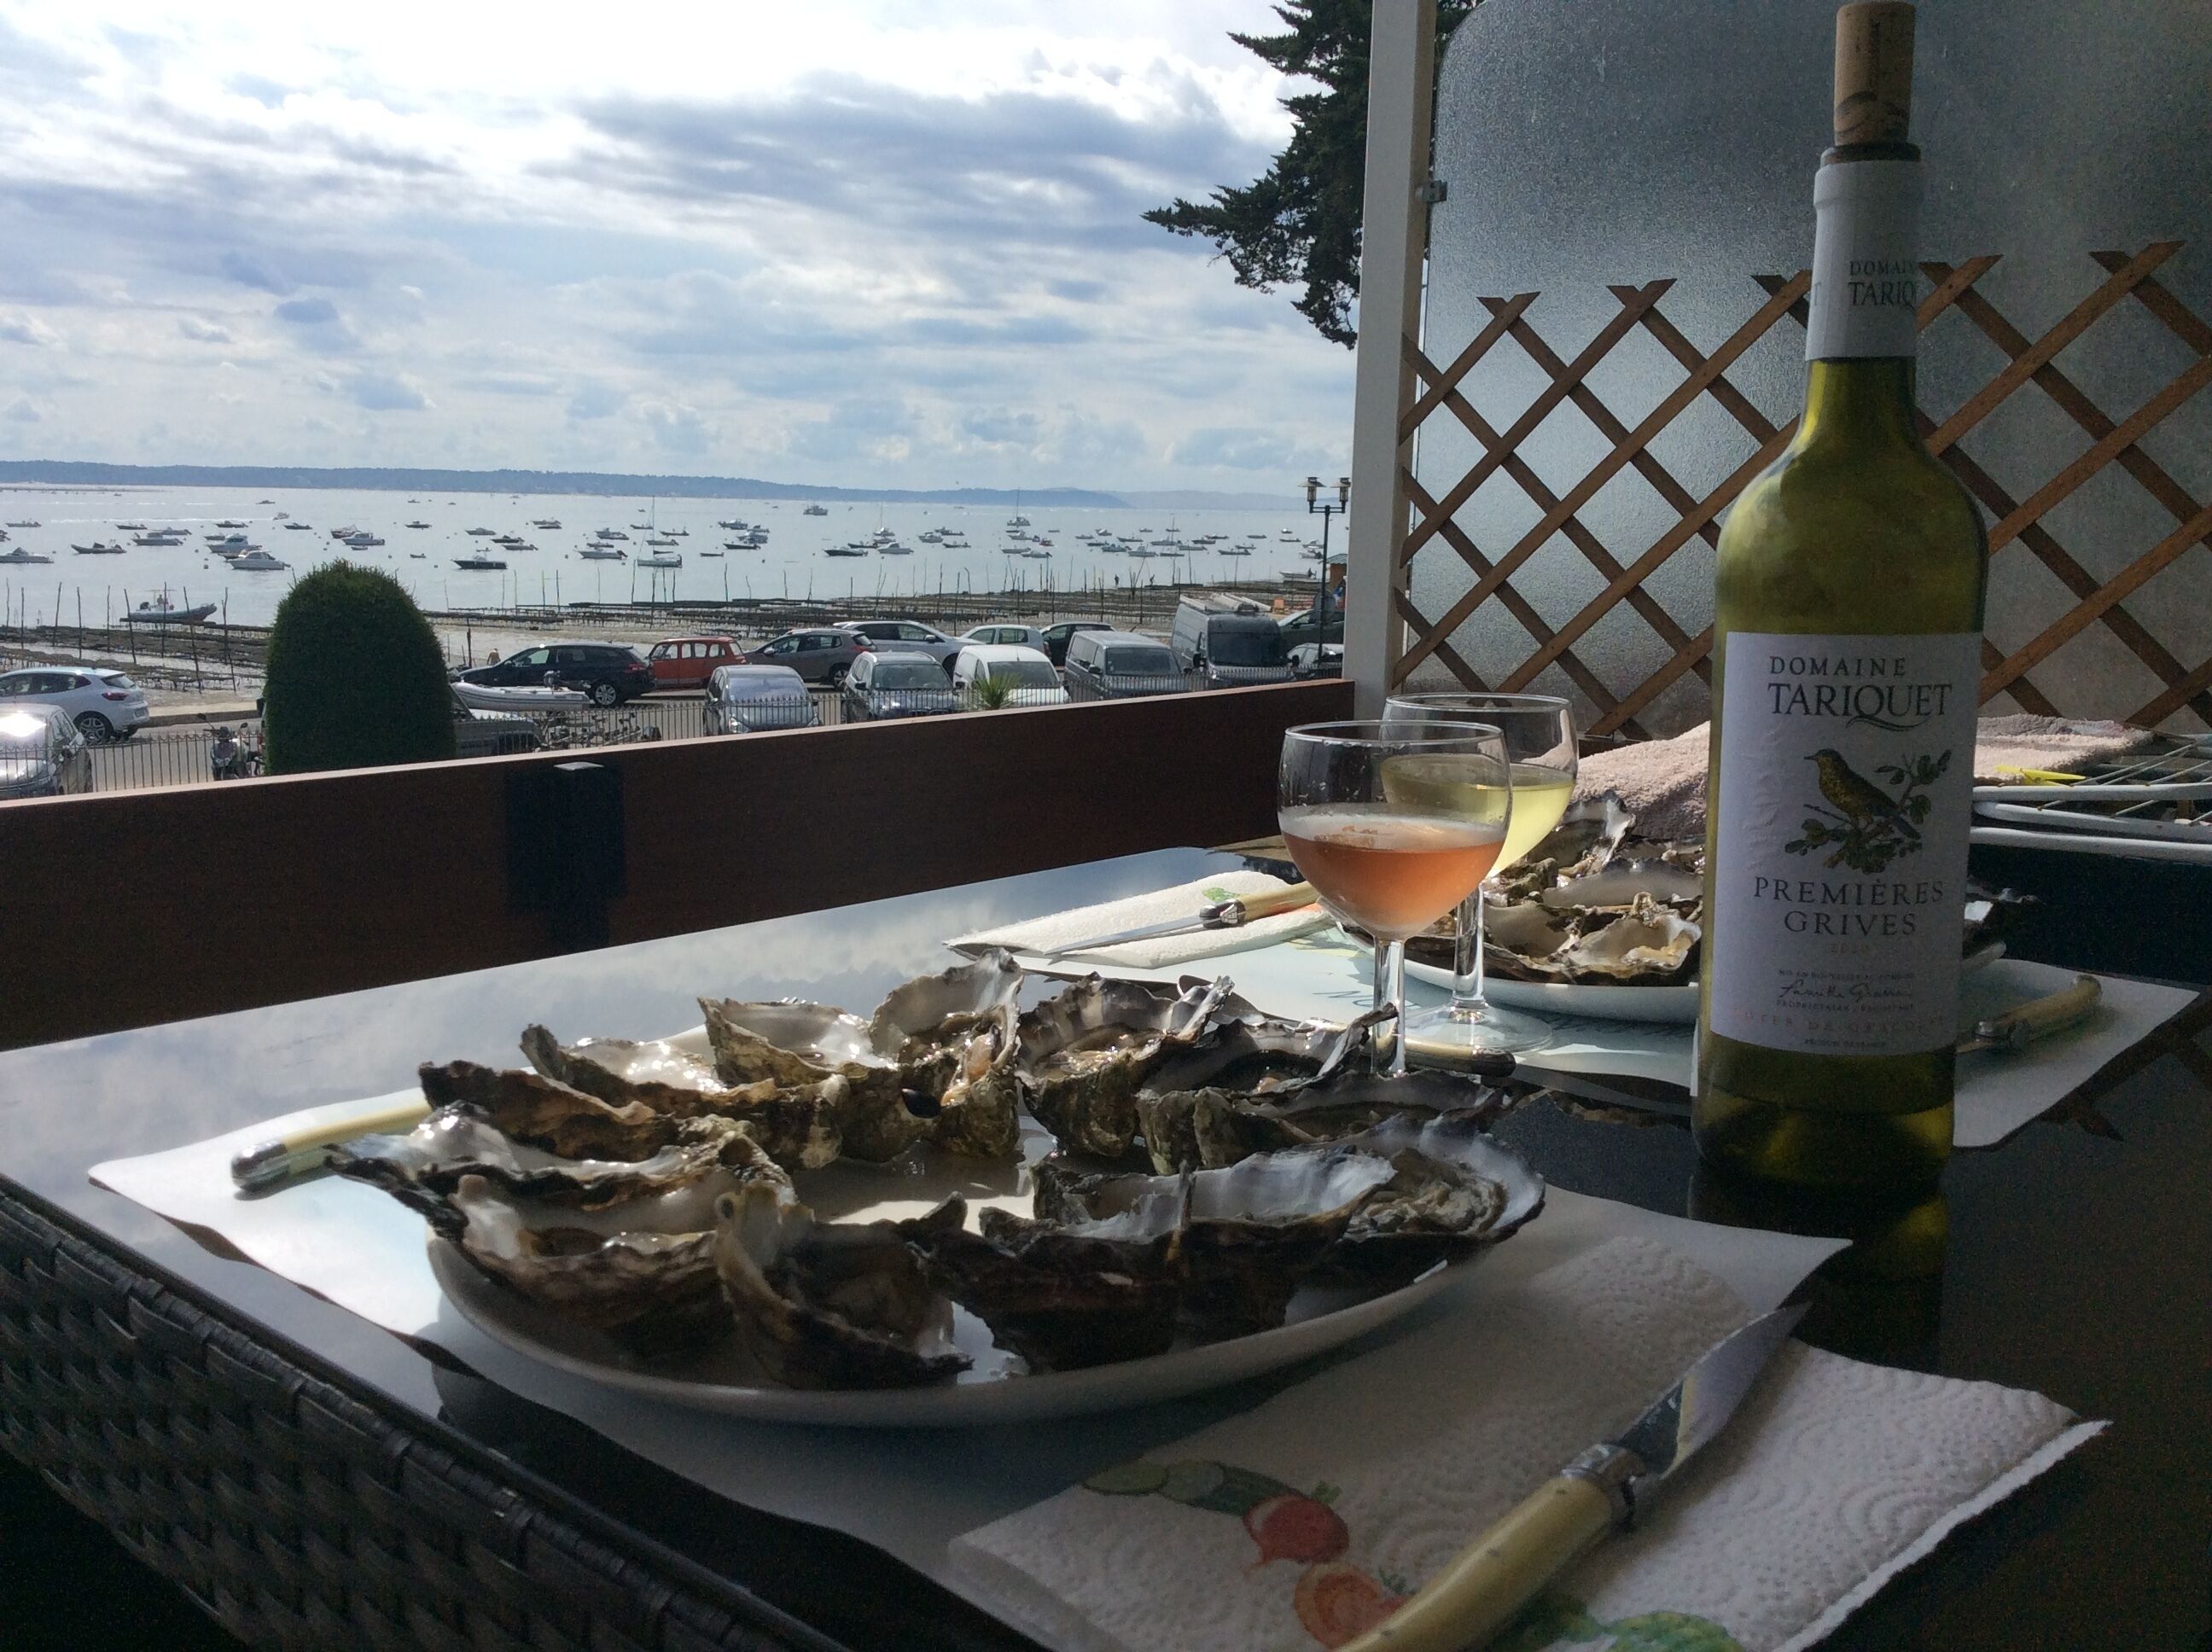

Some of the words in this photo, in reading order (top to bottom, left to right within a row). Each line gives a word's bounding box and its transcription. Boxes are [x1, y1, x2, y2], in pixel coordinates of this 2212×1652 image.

[1769, 655, 1906, 678] DOMAINE
[1767, 682, 1953, 732] TARIQUET
[1753, 875, 1945, 906] PREMIÈRES
[1784, 910, 1917, 937] GRIVES
